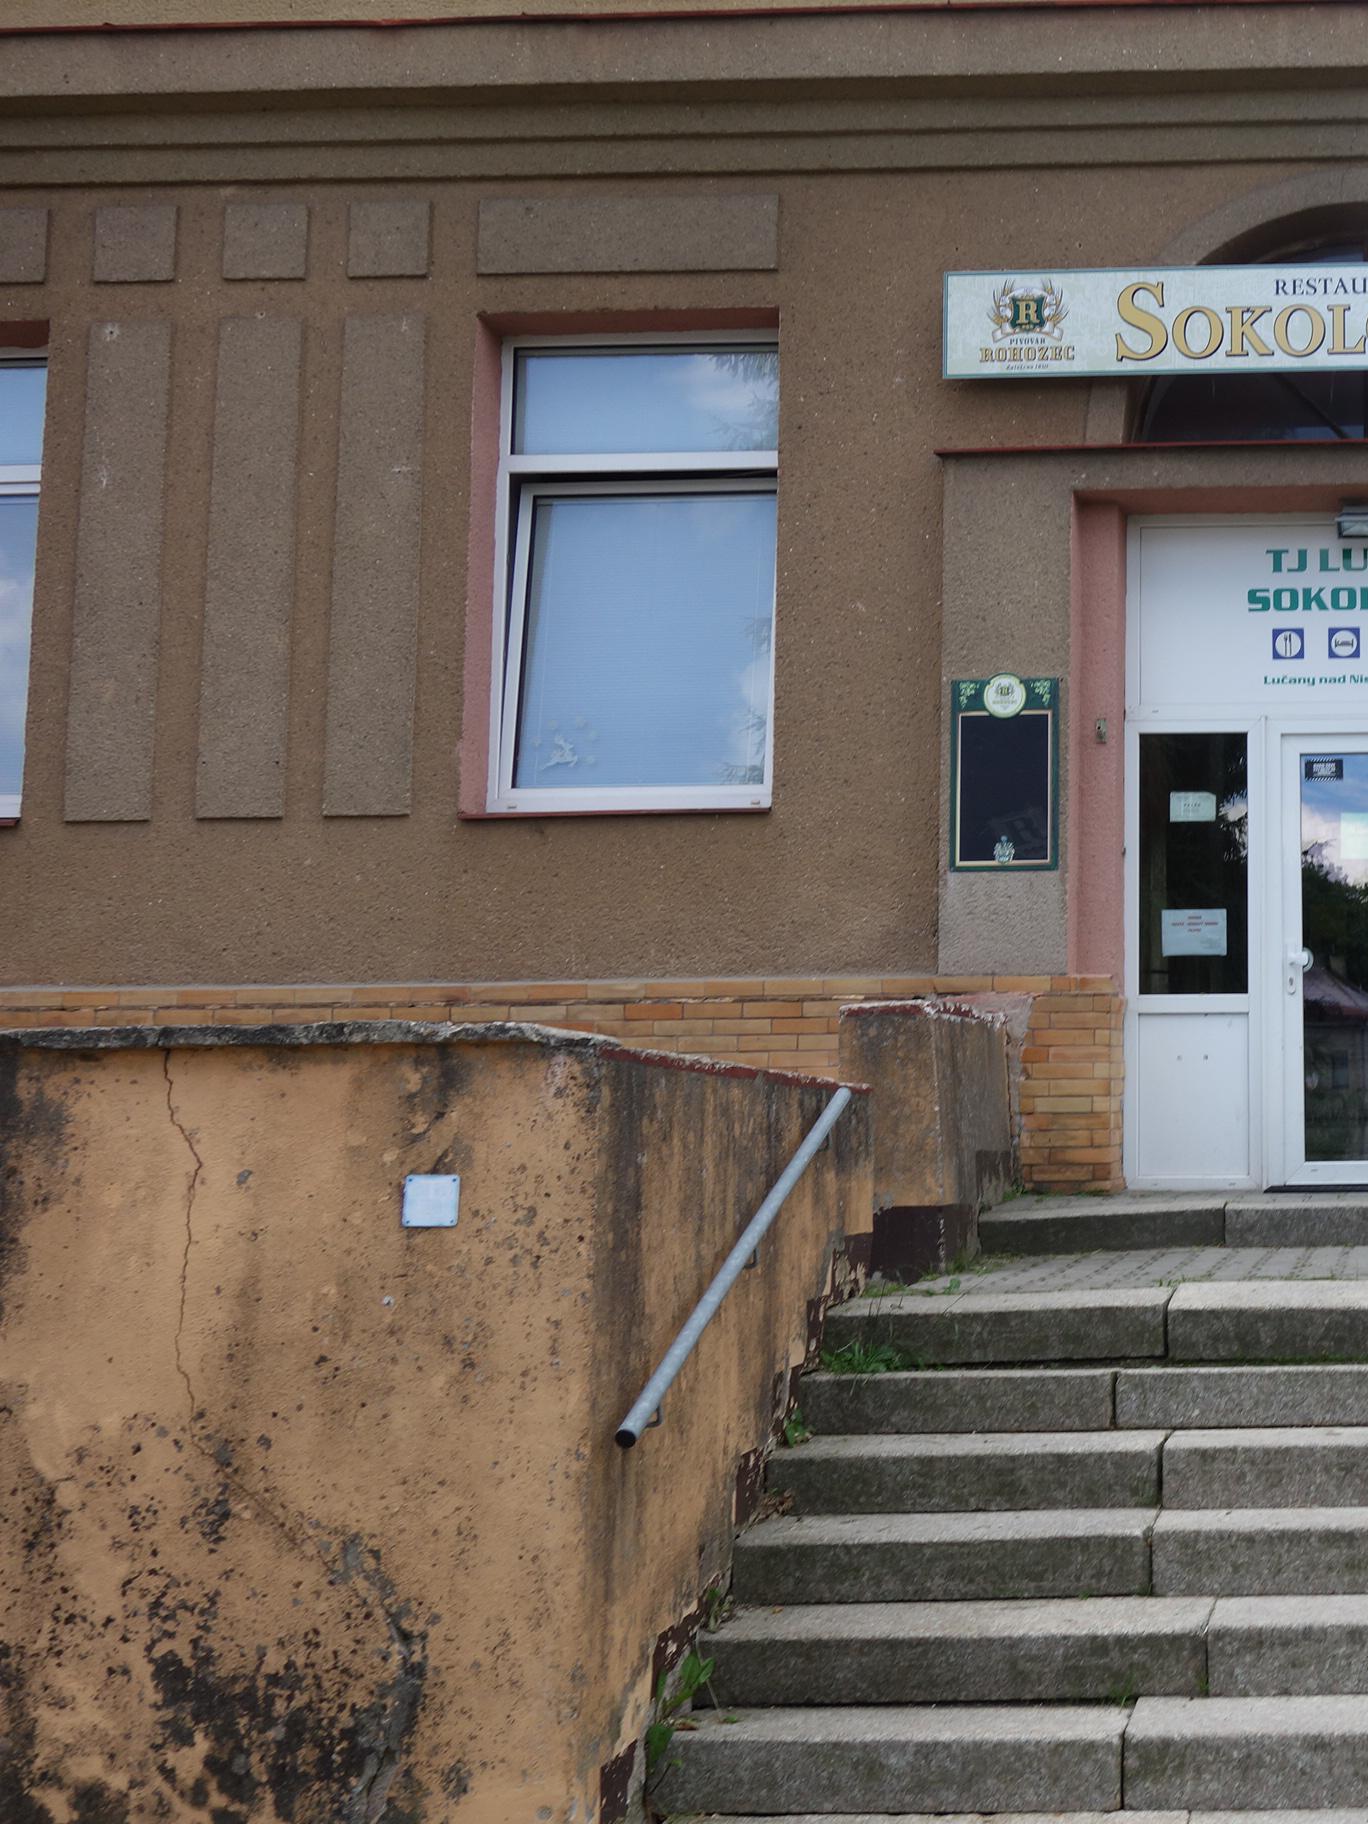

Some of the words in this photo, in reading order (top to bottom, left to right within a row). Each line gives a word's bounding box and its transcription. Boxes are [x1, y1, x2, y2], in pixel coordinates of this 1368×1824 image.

[1015, 300, 1040, 325] R
[1009, 337, 1046, 345] PIVOVAR
[979, 345, 1075, 363] ROHOZEC
[1265, 548, 1308, 573] TJ
[1263, 674, 1316, 686] Lučany
[1319, 674, 1346, 684] nad
